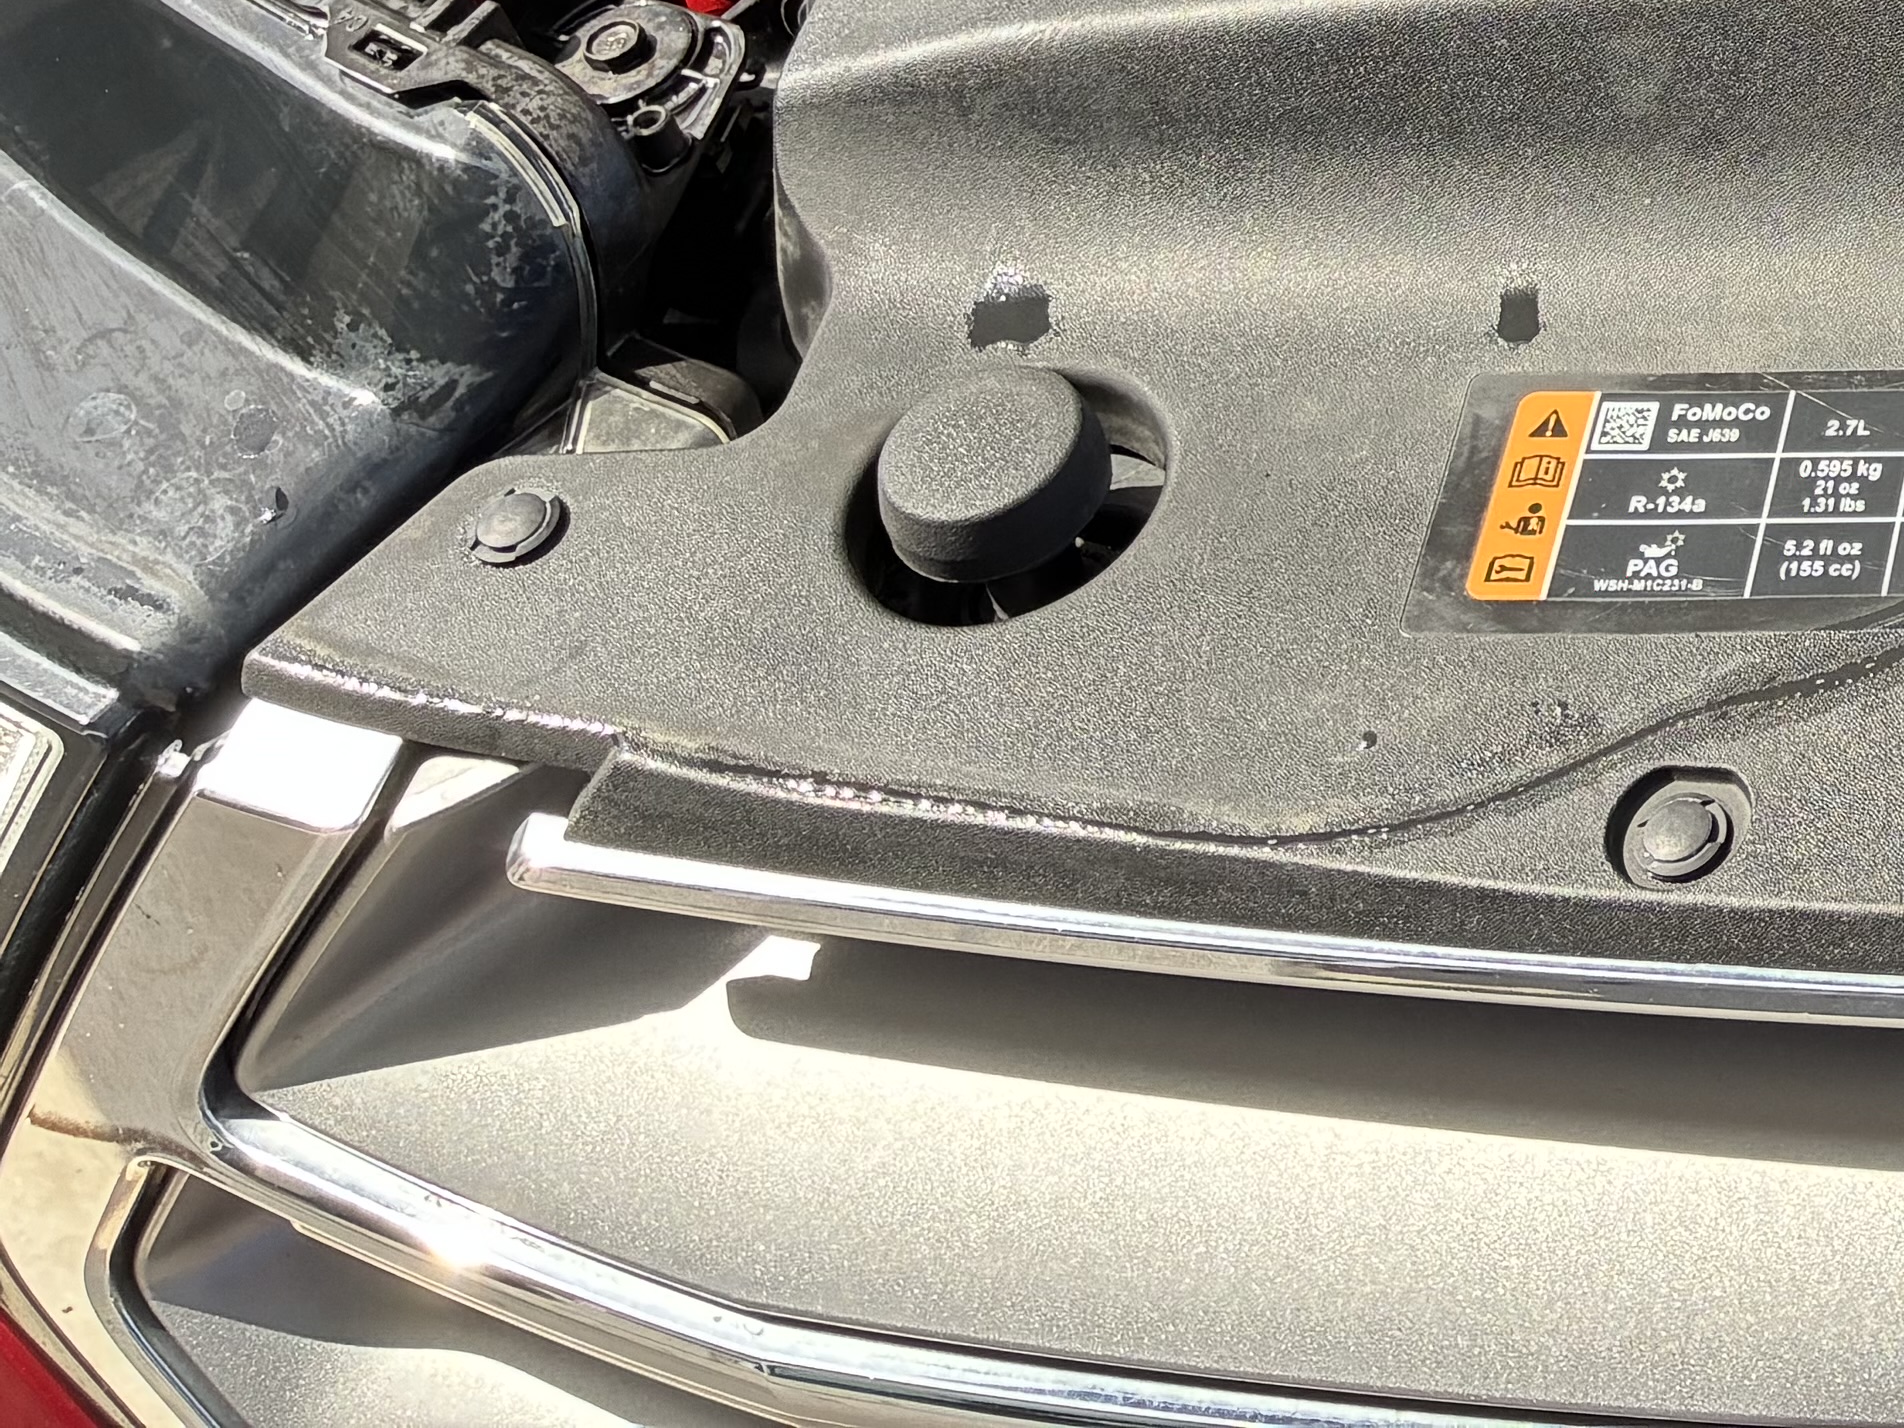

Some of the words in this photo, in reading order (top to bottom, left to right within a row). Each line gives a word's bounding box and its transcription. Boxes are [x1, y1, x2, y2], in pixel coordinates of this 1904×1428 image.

[1671, 403, 1771, 421] FoMoCo
[1667, 429, 1699, 443] SAE
[1702, 428, 1740, 443] J639
[1824, 419, 1870, 437] 2.7L
[1799, 460, 1853, 478] 0.595
[1856, 460, 1883, 481] kg
[1814, 480, 1834, 495] 21
[1838, 481, 1860, 495] oz
[1628, 495, 1706, 513] R-134a
[1801, 498, 1835, 513] 1.31
[1839, 497, 1866, 512] lbs
[1783, 539, 1815, 556] 5.2
[1818, 539, 1833, 556] fl
[1837, 542, 1863, 556] oz
[1626, 559, 1679, 577] PAG
[1779, 560, 1824, 581] (155
[1828, 559, 1861, 580] cc)
